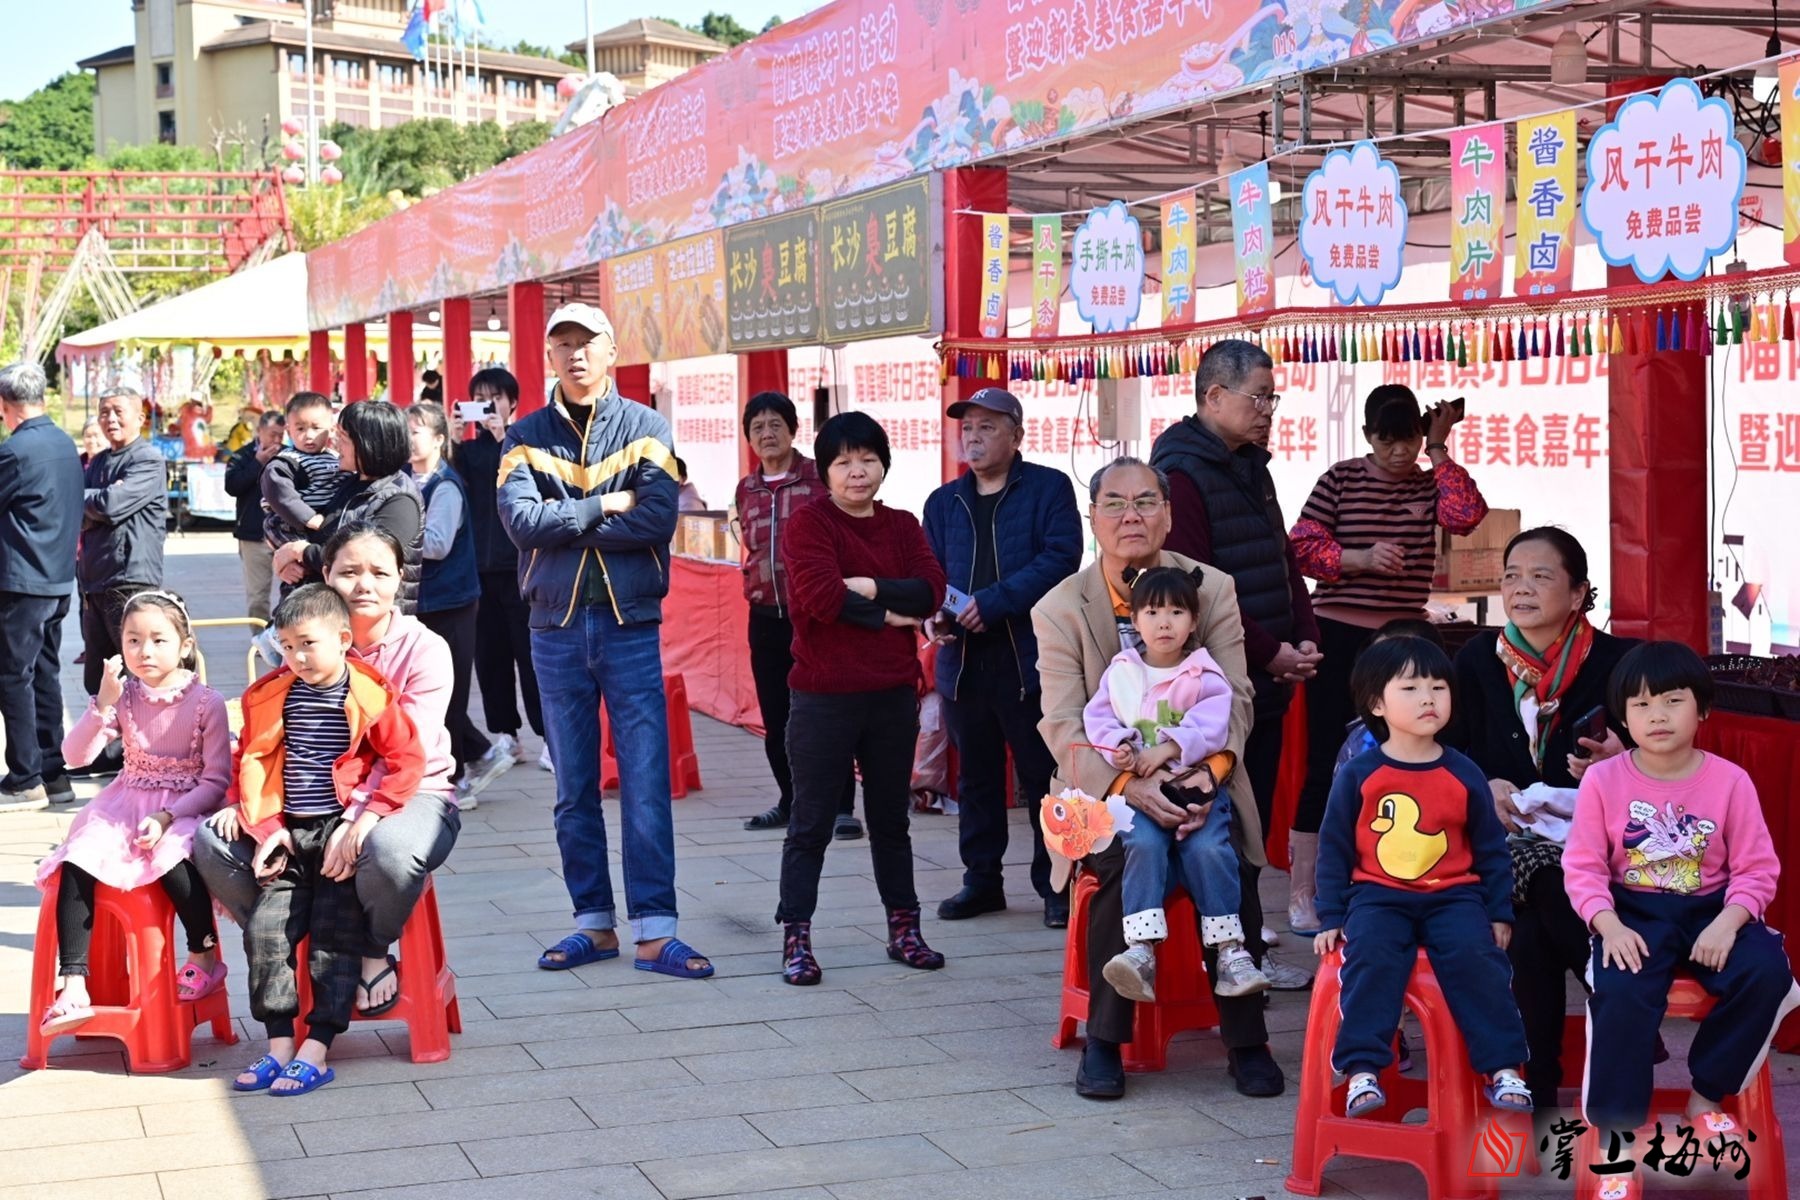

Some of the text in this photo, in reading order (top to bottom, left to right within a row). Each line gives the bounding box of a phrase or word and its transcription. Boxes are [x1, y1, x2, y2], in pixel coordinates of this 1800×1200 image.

[1273, 29, 1296, 58] 018
[1600, 128, 1723, 193] 风干牛肉
[1311, 186, 1394, 229] 风干牛肉
[1459, 137, 1494, 278] 牛肉片
[1527, 128, 1565, 272] 酱香卤
[1625, 203, 1702, 242] 免费品尝
[730, 236, 807, 303] 长沙臭豆腐
[830, 204, 917, 280] 长沙臭豆腐
[986, 223, 1003, 318] 酱香卤
[1079, 237, 1136, 274] 手撕牛肉
[1167, 202, 1189, 316] 牛肉干
[1238, 178, 1269, 299] 牛肉粒
[1329, 243, 1380, 270] 免费品尝
[1036, 224, 1056, 325] 风干条
[1091, 285, 1127, 307] 免费品尝
[1446, 412, 1610, 469] 春美食嘉年
